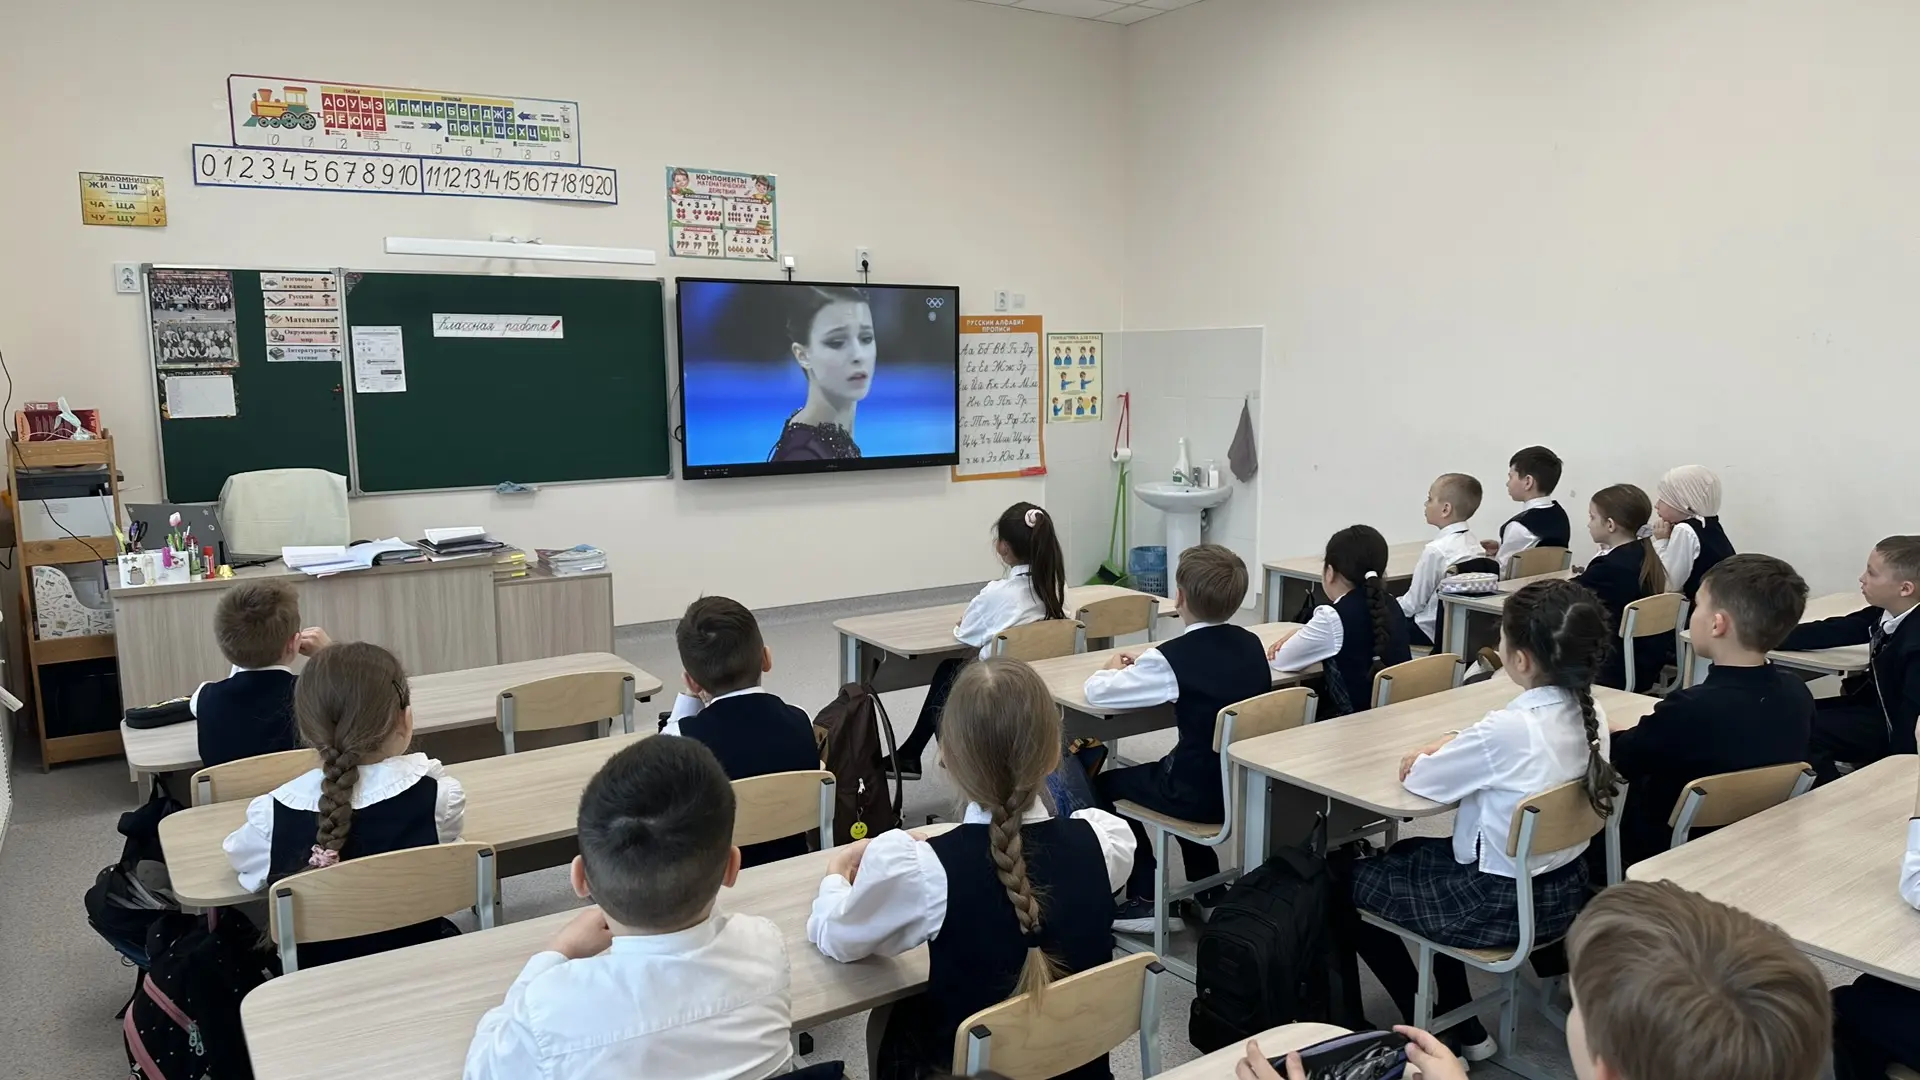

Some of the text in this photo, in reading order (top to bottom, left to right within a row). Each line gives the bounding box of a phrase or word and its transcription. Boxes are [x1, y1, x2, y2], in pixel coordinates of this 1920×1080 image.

[202, 153, 612, 196] 0 1 2 3 4 5 6 7 8 9 10 11 12 13 14 15 16 17 18 19 20
[696, 174, 747, 184] КОМПОНЕНТЫ
[88, 181, 108, 189] ЖИ
[90, 200, 136, 210] ЧА ЩА
[117, 215, 136, 223] ЩУ
[439, 316, 548, 336] Классная работа
